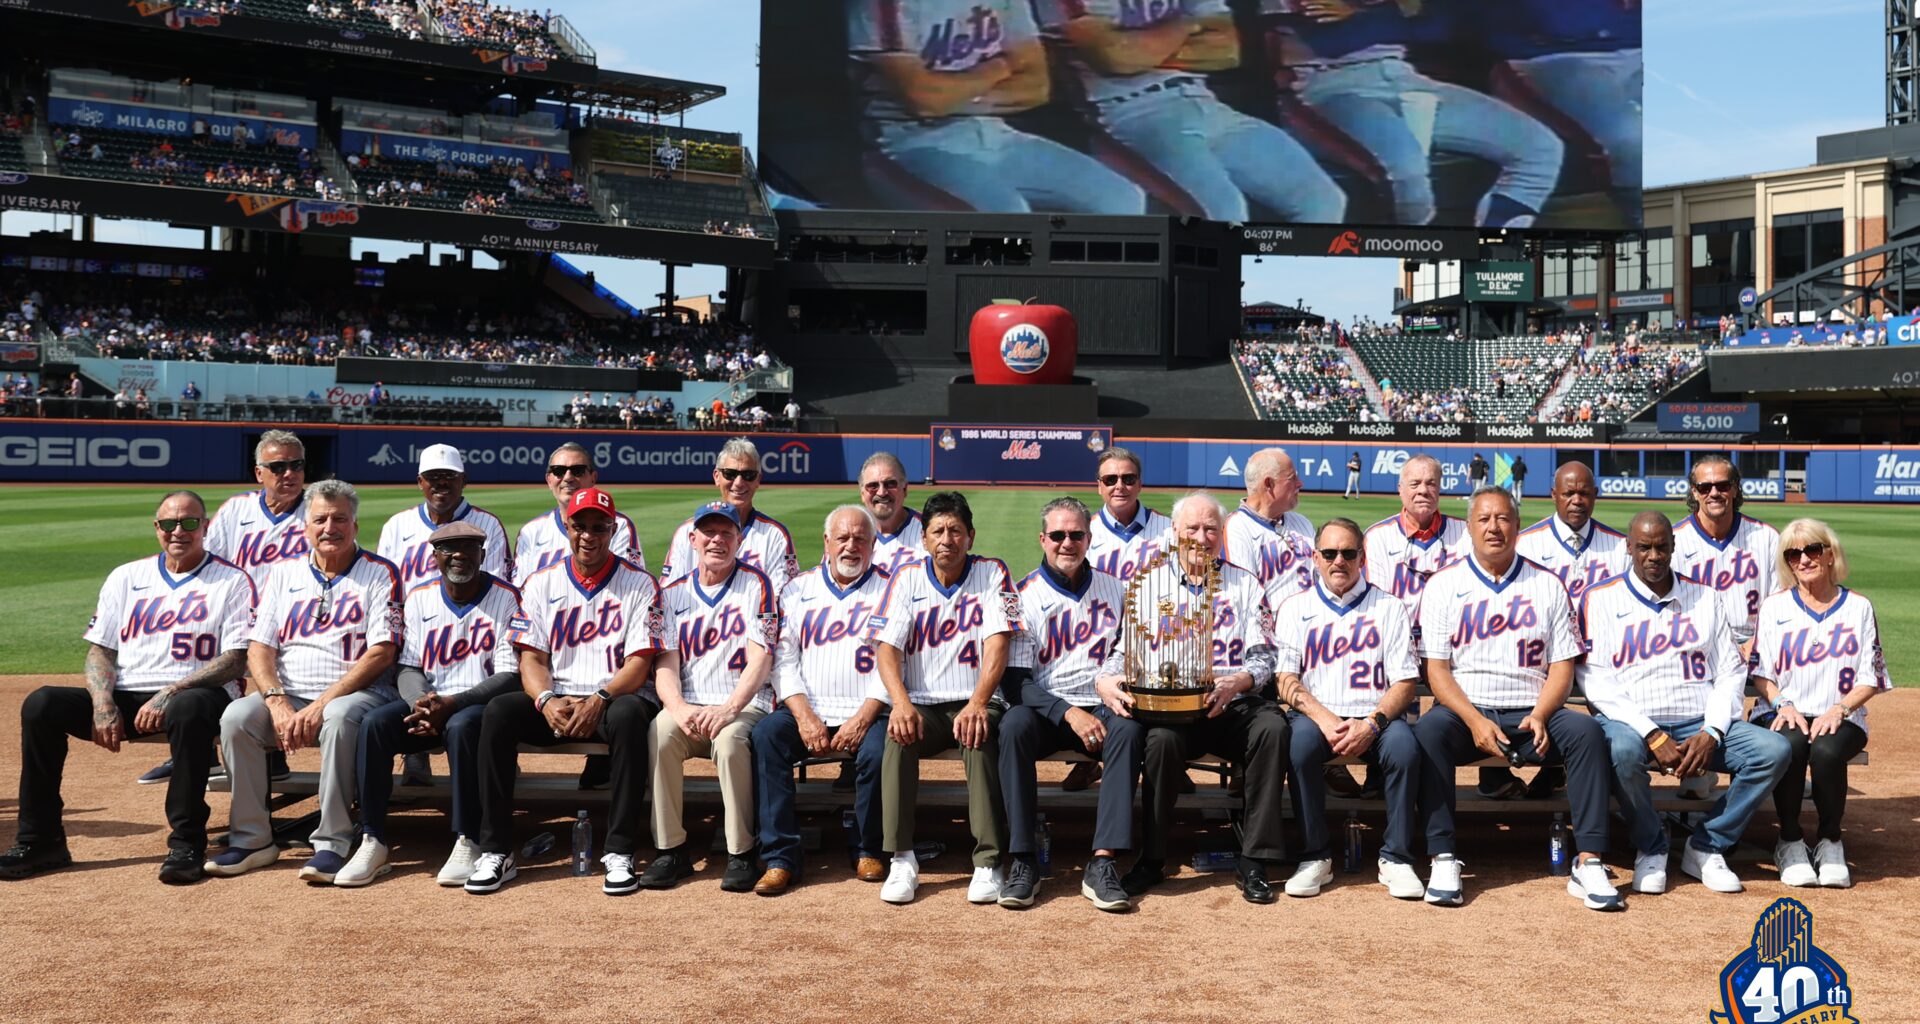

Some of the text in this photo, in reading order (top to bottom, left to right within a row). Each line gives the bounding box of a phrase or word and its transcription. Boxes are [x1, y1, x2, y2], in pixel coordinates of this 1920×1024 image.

[331, 42, 393, 56] ANNIVERSARY
[116, 114, 187, 132] MILAGRO
[393, 144, 418, 157] THE
[451, 150, 494, 164] PORCH
[481, 235, 599, 252] 40TH ANNIVERSARY
[1244, 230, 1293, 240] 04:07 PM
[1365, 238, 1443, 252] moomoo
[1475, 271, 1525, 282] TULLAMORE
[1007, 341, 1041, 359] Mets
[118, 377, 159, 391] Chill
[450, 376, 536, 386] 40TH ANNIVERSARY
[498, 398, 537, 412] DECK
[1669, 404, 1747, 414] 50/50 JACKPOT
[1288, 422, 1334, 436] HubSpot
[1349, 423, 1395, 437] HubSpot
[1415, 423, 1461, 437] HubSpot
[1487, 424, 1534, 438] HubSpot
[1546, 424, 1593, 438] HubSpot
[1682, 414, 1733, 430] $5,010
[961, 429, 1083, 441] 1986 WORLD SERIES CHAMPIONS
[0, 436, 171, 468] GEICO
[499, 446, 546, 465] QQQ
[617, 445, 716, 466] Guardian
[761, 446, 810, 474] citi
[1002, 440, 1042, 460] Mets
[1601, 479, 1647, 493] GOYA
[1665, 479, 1688, 494] GO
[1742, 480, 1779, 495] OYA
[574, 490, 610, 507] F G
[1096, 541, 1162, 581] Mets
[1690, 548, 1759, 591] Mets
[120, 590, 209, 643] Mets
[278, 591, 365, 644] Mets
[549, 598, 625, 652] Mets
[907, 594, 984, 656] Mets
[1450, 594, 1539, 651] Mets
[678, 603, 746, 662] Mets
[1038, 597, 1118, 666] Mets
[1612, 612, 1700, 670] Mets
[170, 632, 217, 662] 50
[340, 632, 368, 662] 17
[422, 617, 496, 671] Mets
[1211, 637, 1245, 668] 22
[1299, 614, 1381, 673] Mets
[1516, 637, 1547, 669] 12
[1775, 622, 1860, 677] Mets
[854, 644, 877, 675] 6
[958, 639, 980, 670] 4
[1349, 660, 1385, 691] 20
[1679, 650, 1707, 681] 16
[1837, 665, 1857, 695] 8
